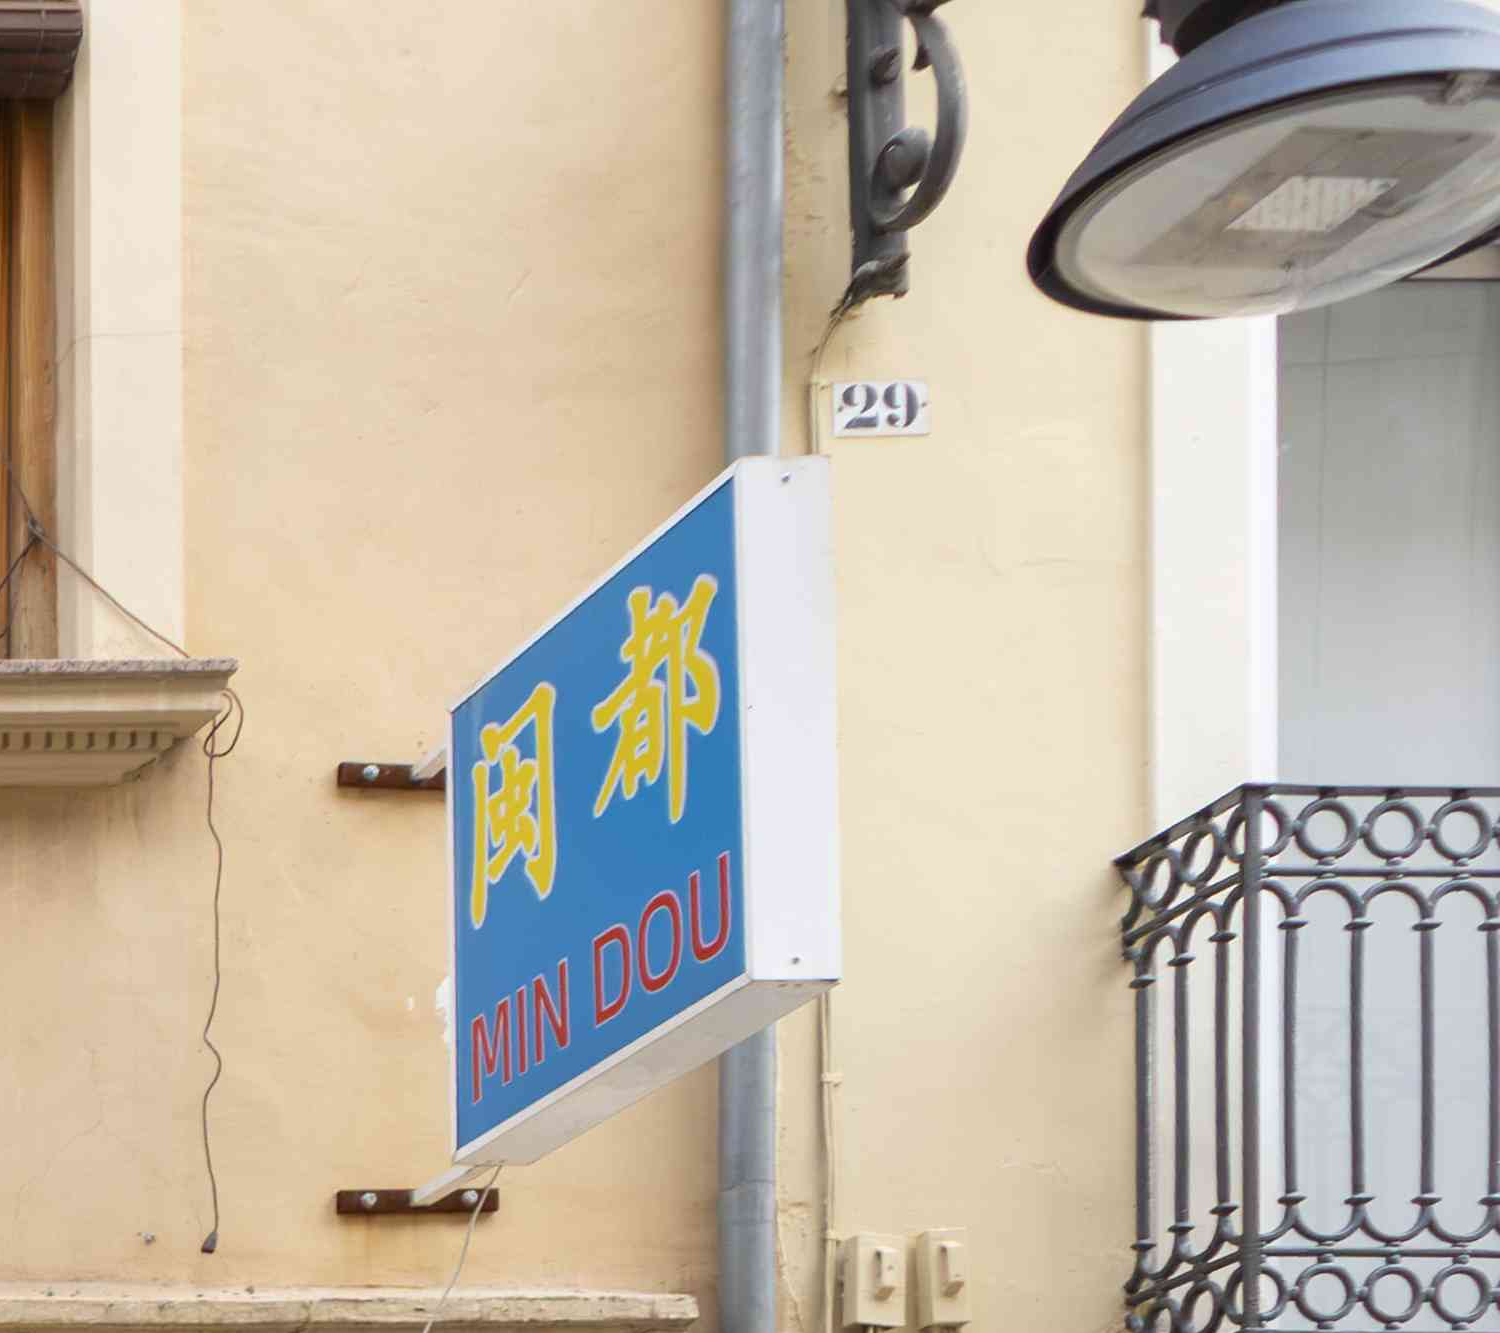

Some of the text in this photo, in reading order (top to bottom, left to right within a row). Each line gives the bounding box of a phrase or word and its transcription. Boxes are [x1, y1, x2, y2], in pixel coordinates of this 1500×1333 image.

[842, 382, 919, 429] 29
[469, 572, 721, 930] 闽都
[471, 851, 731, 1104] MIN DOU
